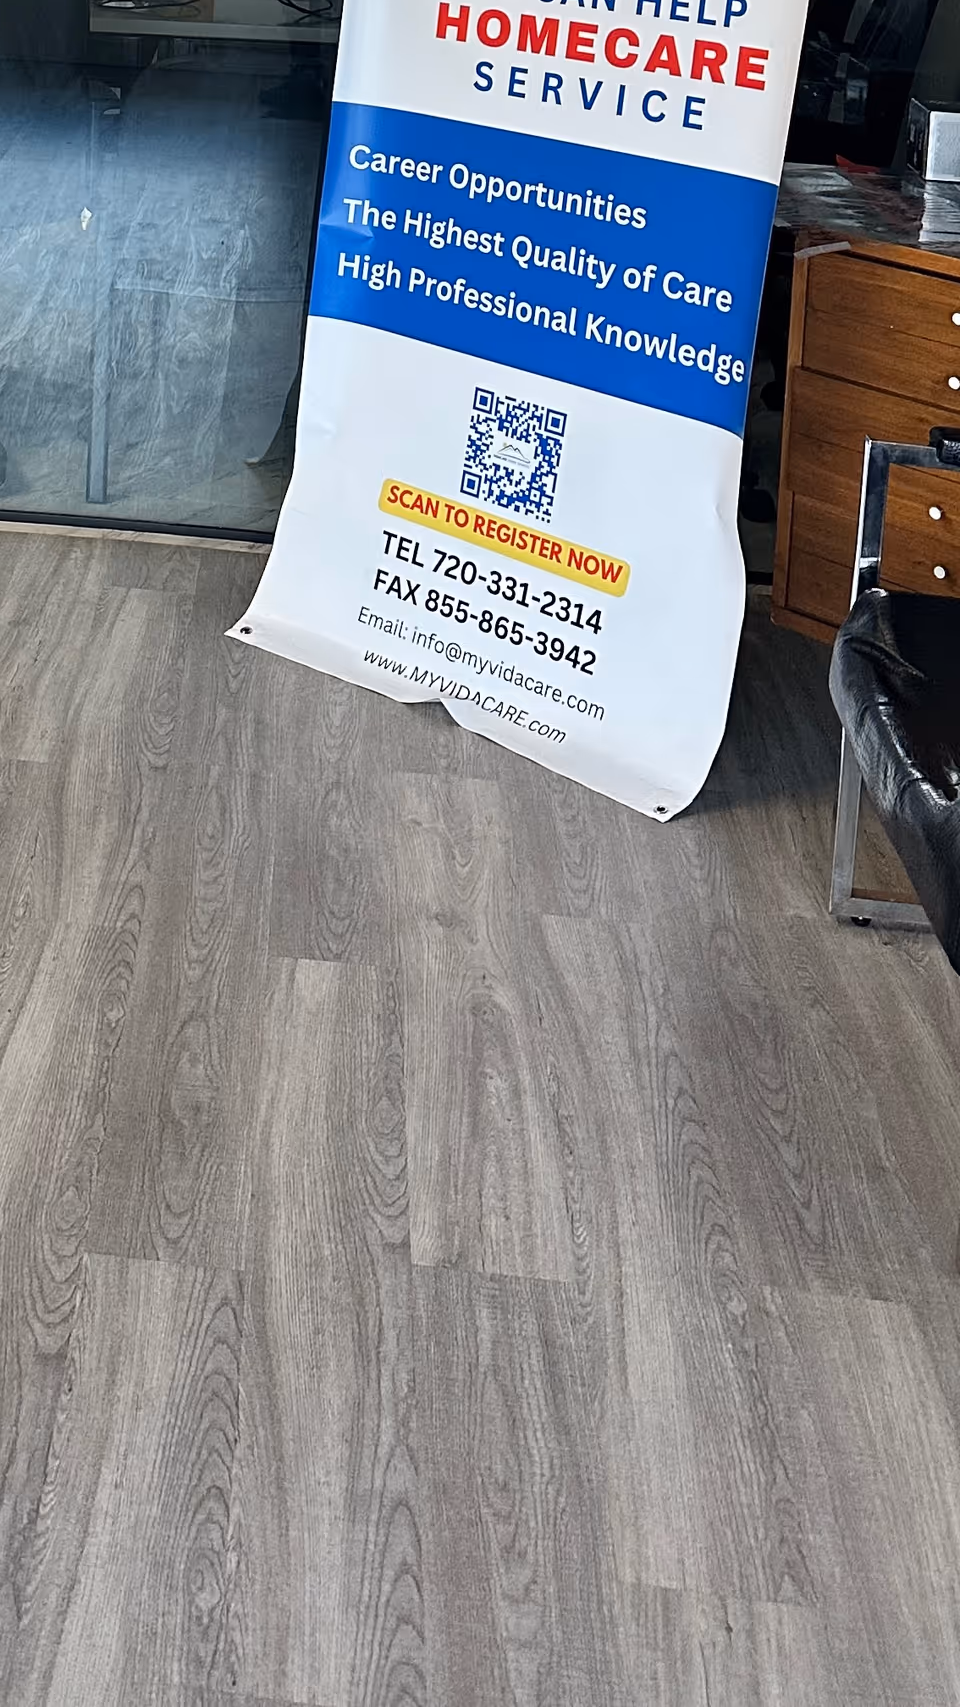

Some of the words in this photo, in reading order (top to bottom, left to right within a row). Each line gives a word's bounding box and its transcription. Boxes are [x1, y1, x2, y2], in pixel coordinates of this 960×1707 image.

[436, 2, 770, 91] HOMECARE
[473, 61, 706, 131] SERVICE
[349, 144, 443, 184] Career
[449, 163, 647, 229] Opportunities
[343, 198, 397, 230] The
[403, 209, 505, 257] Highest
[511, 235, 616, 289] Quality
[623, 264, 657, 293] of
[662, 271, 732, 313] Care
[337, 252, 402, 290] High
[408, 267, 577, 336] Professional
[585, 312, 745, 386] Knowledge
[382, 530, 424, 567] TEL
[432, 548, 603, 634] 720-331-2314
[387, 485, 440, 519] SCAN
[445, 503, 469, 528] TO
[473, 517, 562, 563] REGISTER
[567, 547, 623, 584] NOW
[357, 606, 407, 640] Email:
[411, 626, 605, 721] info@myvidacare.com
[373, 568, 421, 606] FAX
[425, 589, 596, 675] 855-865-3942
[363, 650, 566, 744] www.MYVIDACARE.com
